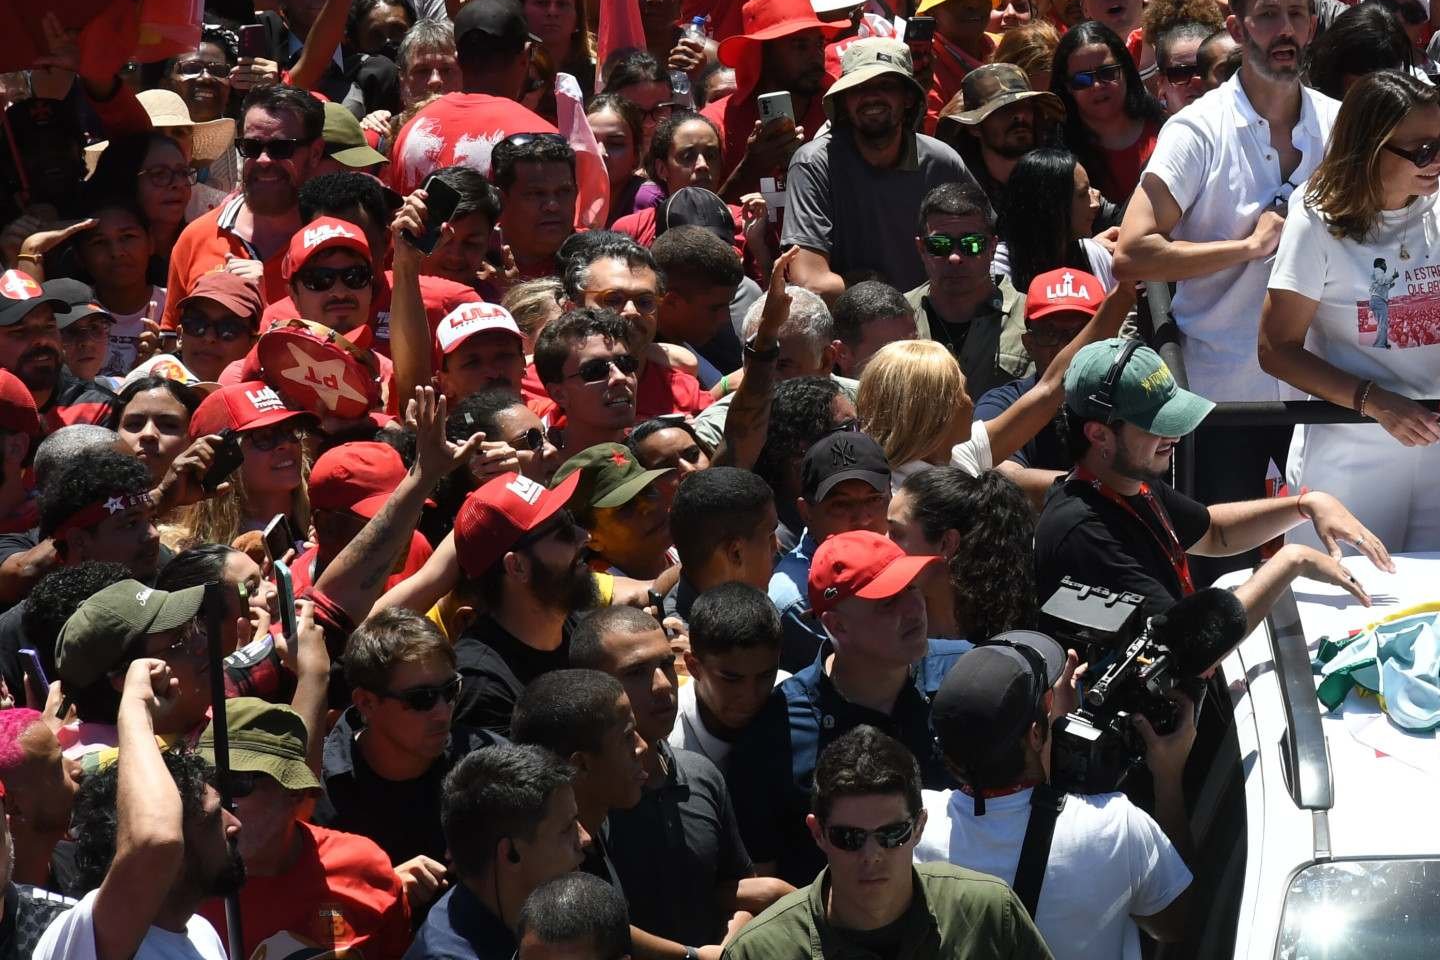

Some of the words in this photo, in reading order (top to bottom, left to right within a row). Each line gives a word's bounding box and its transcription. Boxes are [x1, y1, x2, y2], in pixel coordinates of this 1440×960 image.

[1404, 270, 1413, 282] A
[1046, 283, 1090, 301] LULA
[1408, 283, 1426, 296] QUE
[450, 303, 507, 330] LULA
[304, 366, 339, 390] PT
